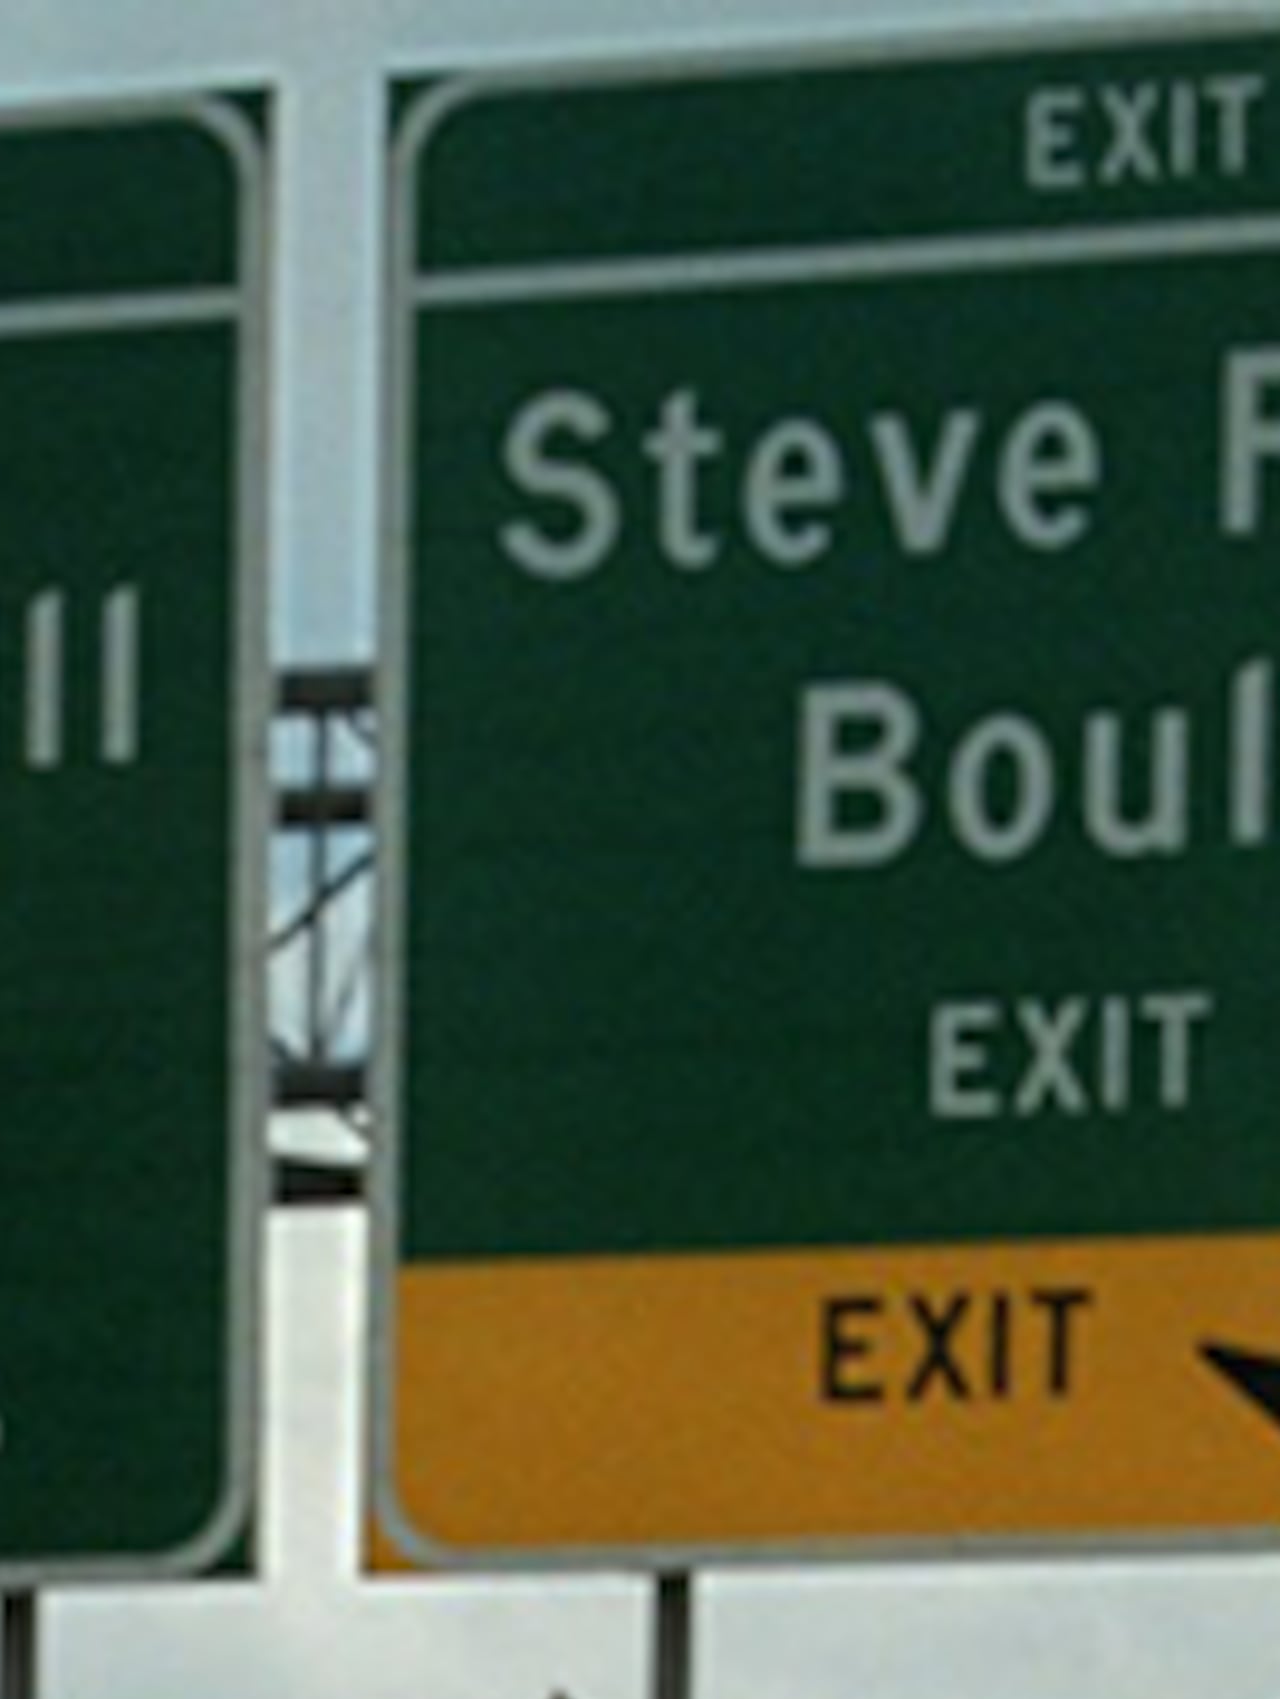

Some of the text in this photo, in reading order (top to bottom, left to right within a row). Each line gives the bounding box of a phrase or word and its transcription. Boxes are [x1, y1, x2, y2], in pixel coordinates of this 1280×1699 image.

[1024, 72, 1265, 190] EXIT
[501, 390, 1099, 579] Steve
[929, 991, 1212, 1118] EXIT
[819, 1286, 1094, 1407] EXIT
